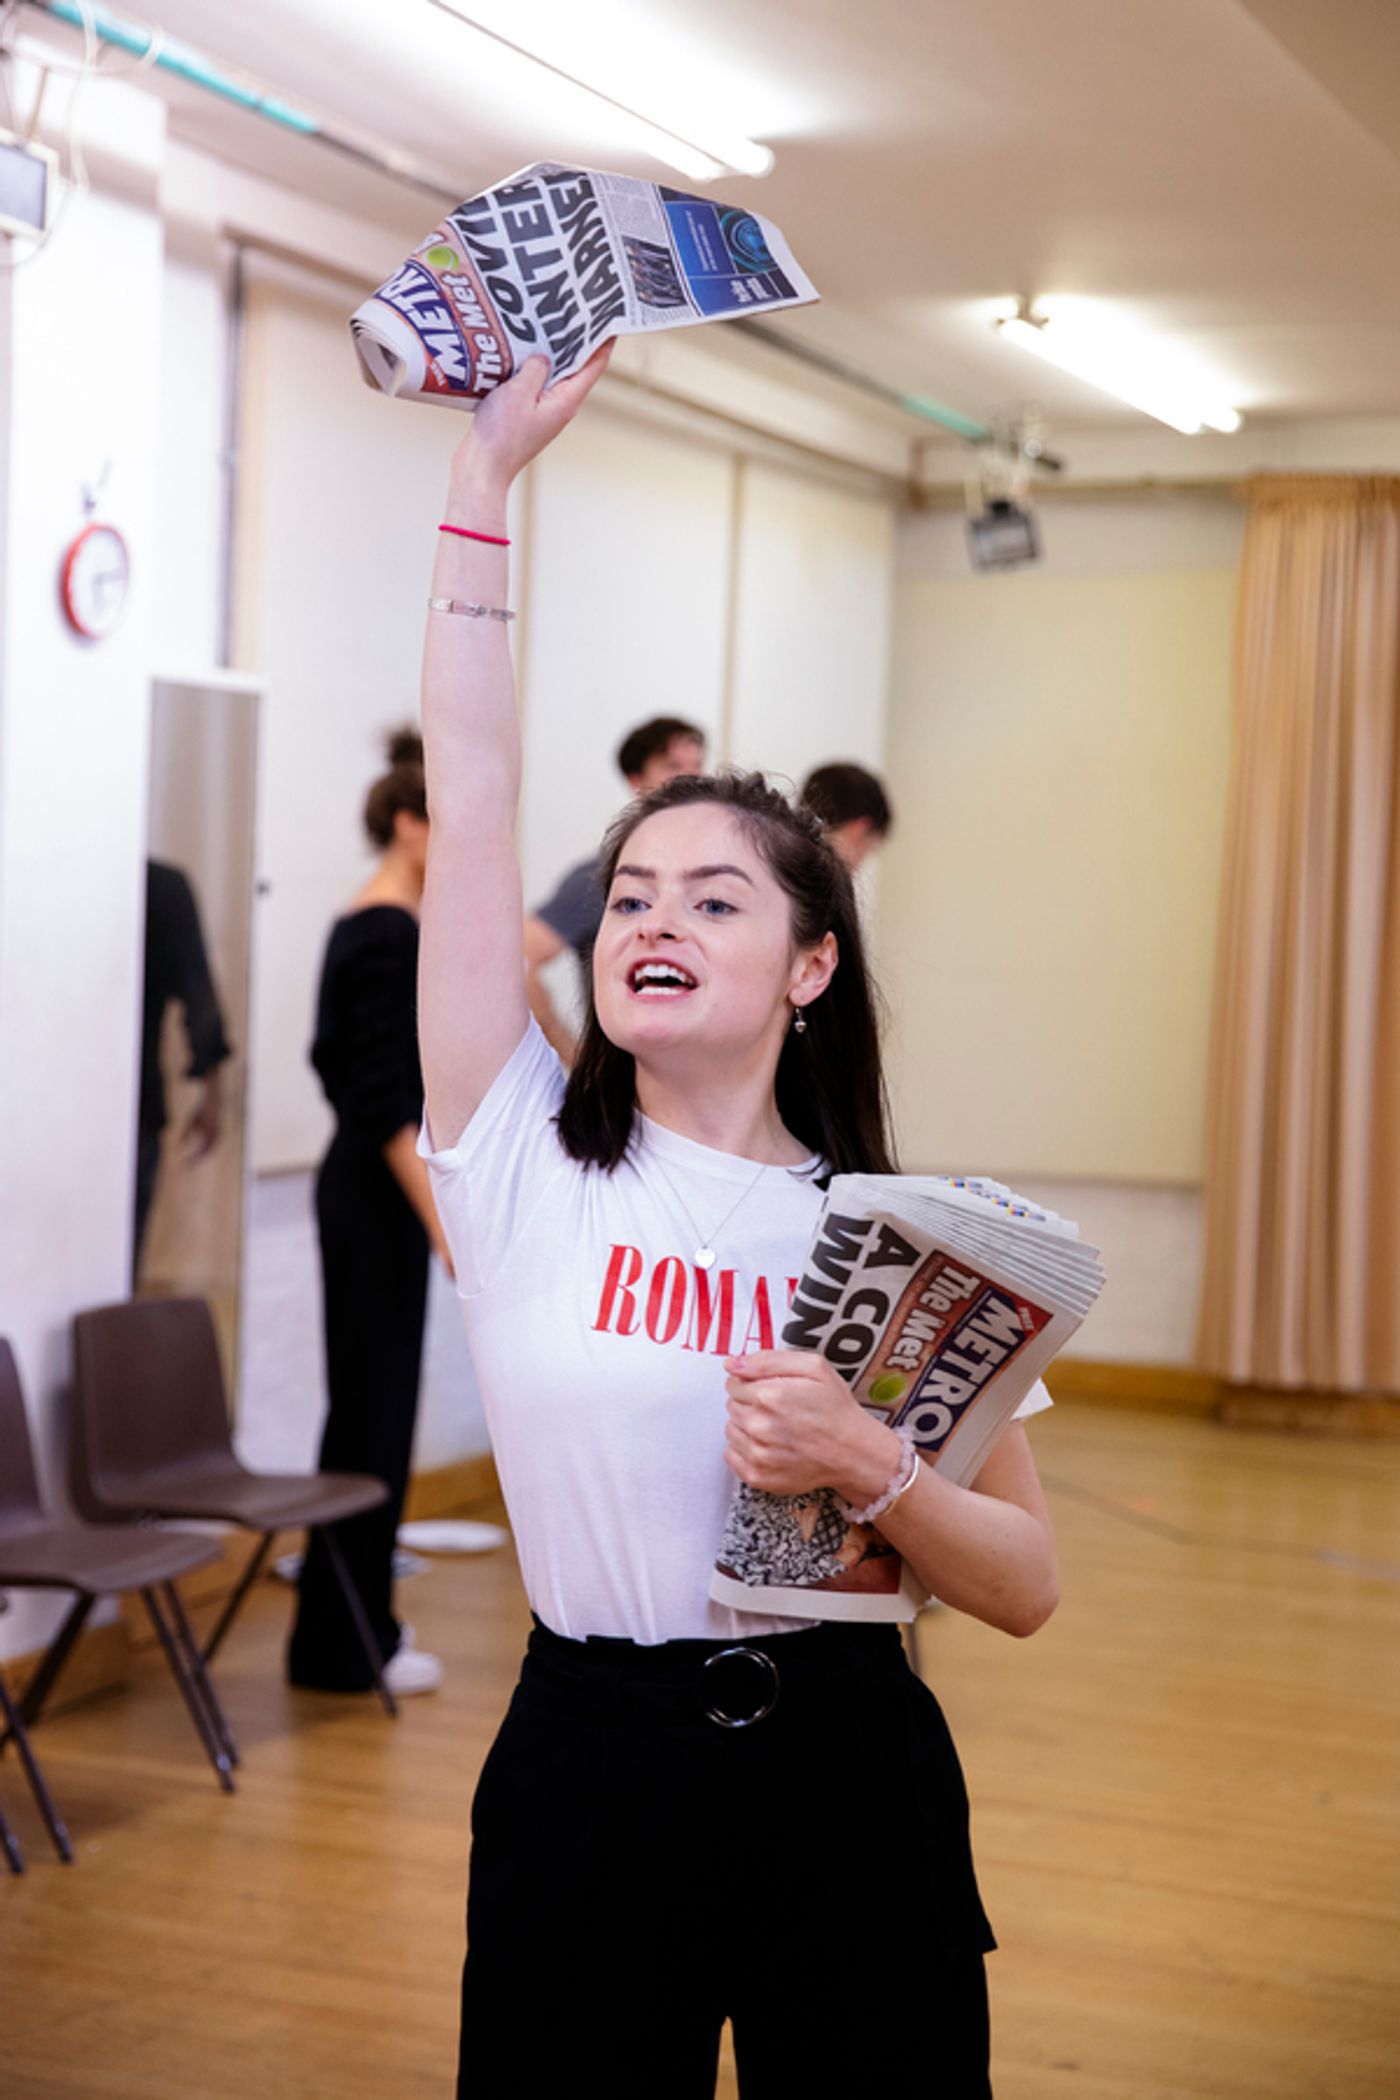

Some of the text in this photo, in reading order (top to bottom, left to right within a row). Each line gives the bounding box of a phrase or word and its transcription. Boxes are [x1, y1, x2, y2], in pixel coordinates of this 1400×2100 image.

[379, 266, 466, 381] METR
[441, 274, 501, 391] The Met
[493, 180, 585, 377] WINTER
[591, 1244, 799, 1356] ROMA
[782, 1213, 874, 1349] WIN
[863, 1223, 921, 1269] A
[886, 1266, 980, 1370] The Met
[904, 1297, 1023, 1444] METRO
